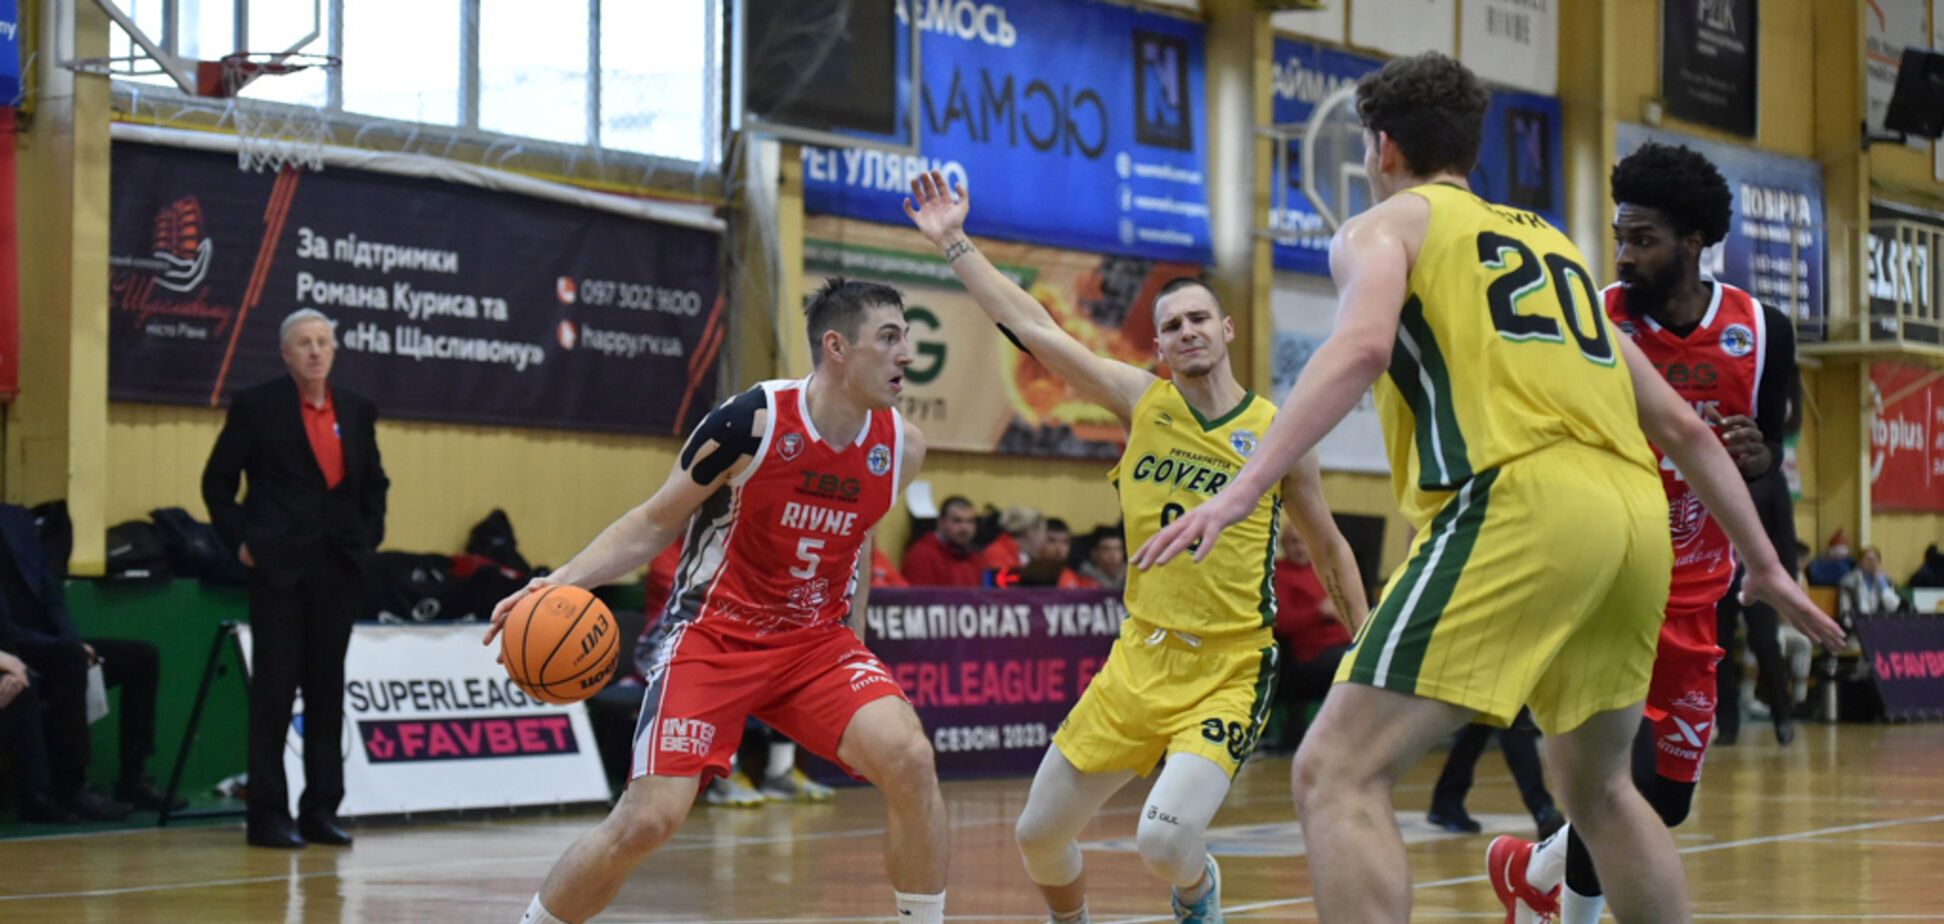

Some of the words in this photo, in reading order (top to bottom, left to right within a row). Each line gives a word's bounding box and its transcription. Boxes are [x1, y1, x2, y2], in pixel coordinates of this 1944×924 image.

[297, 227, 329, 260] За
[333, 232, 459, 275] підтримки
[296, 271, 390, 311] Романа
[393, 281, 478, 321] Куриса
[481, 295, 509, 322] та
[1477, 231, 1617, 369] 20
[1655, 363, 1718, 385] BG
[800, 469, 861, 497] TBG
[1133, 455, 1228, 494] GOVER
[780, 501, 858, 536] RIVNE
[789, 536, 825, 580] 5
[867, 603, 1032, 640] ЧЕМПІОНАТ
[894, 658, 1066, 707] ERLEAGUE
[397, 716, 569, 758] FAVBET
[934, 726, 999, 752] СЕЗОН
